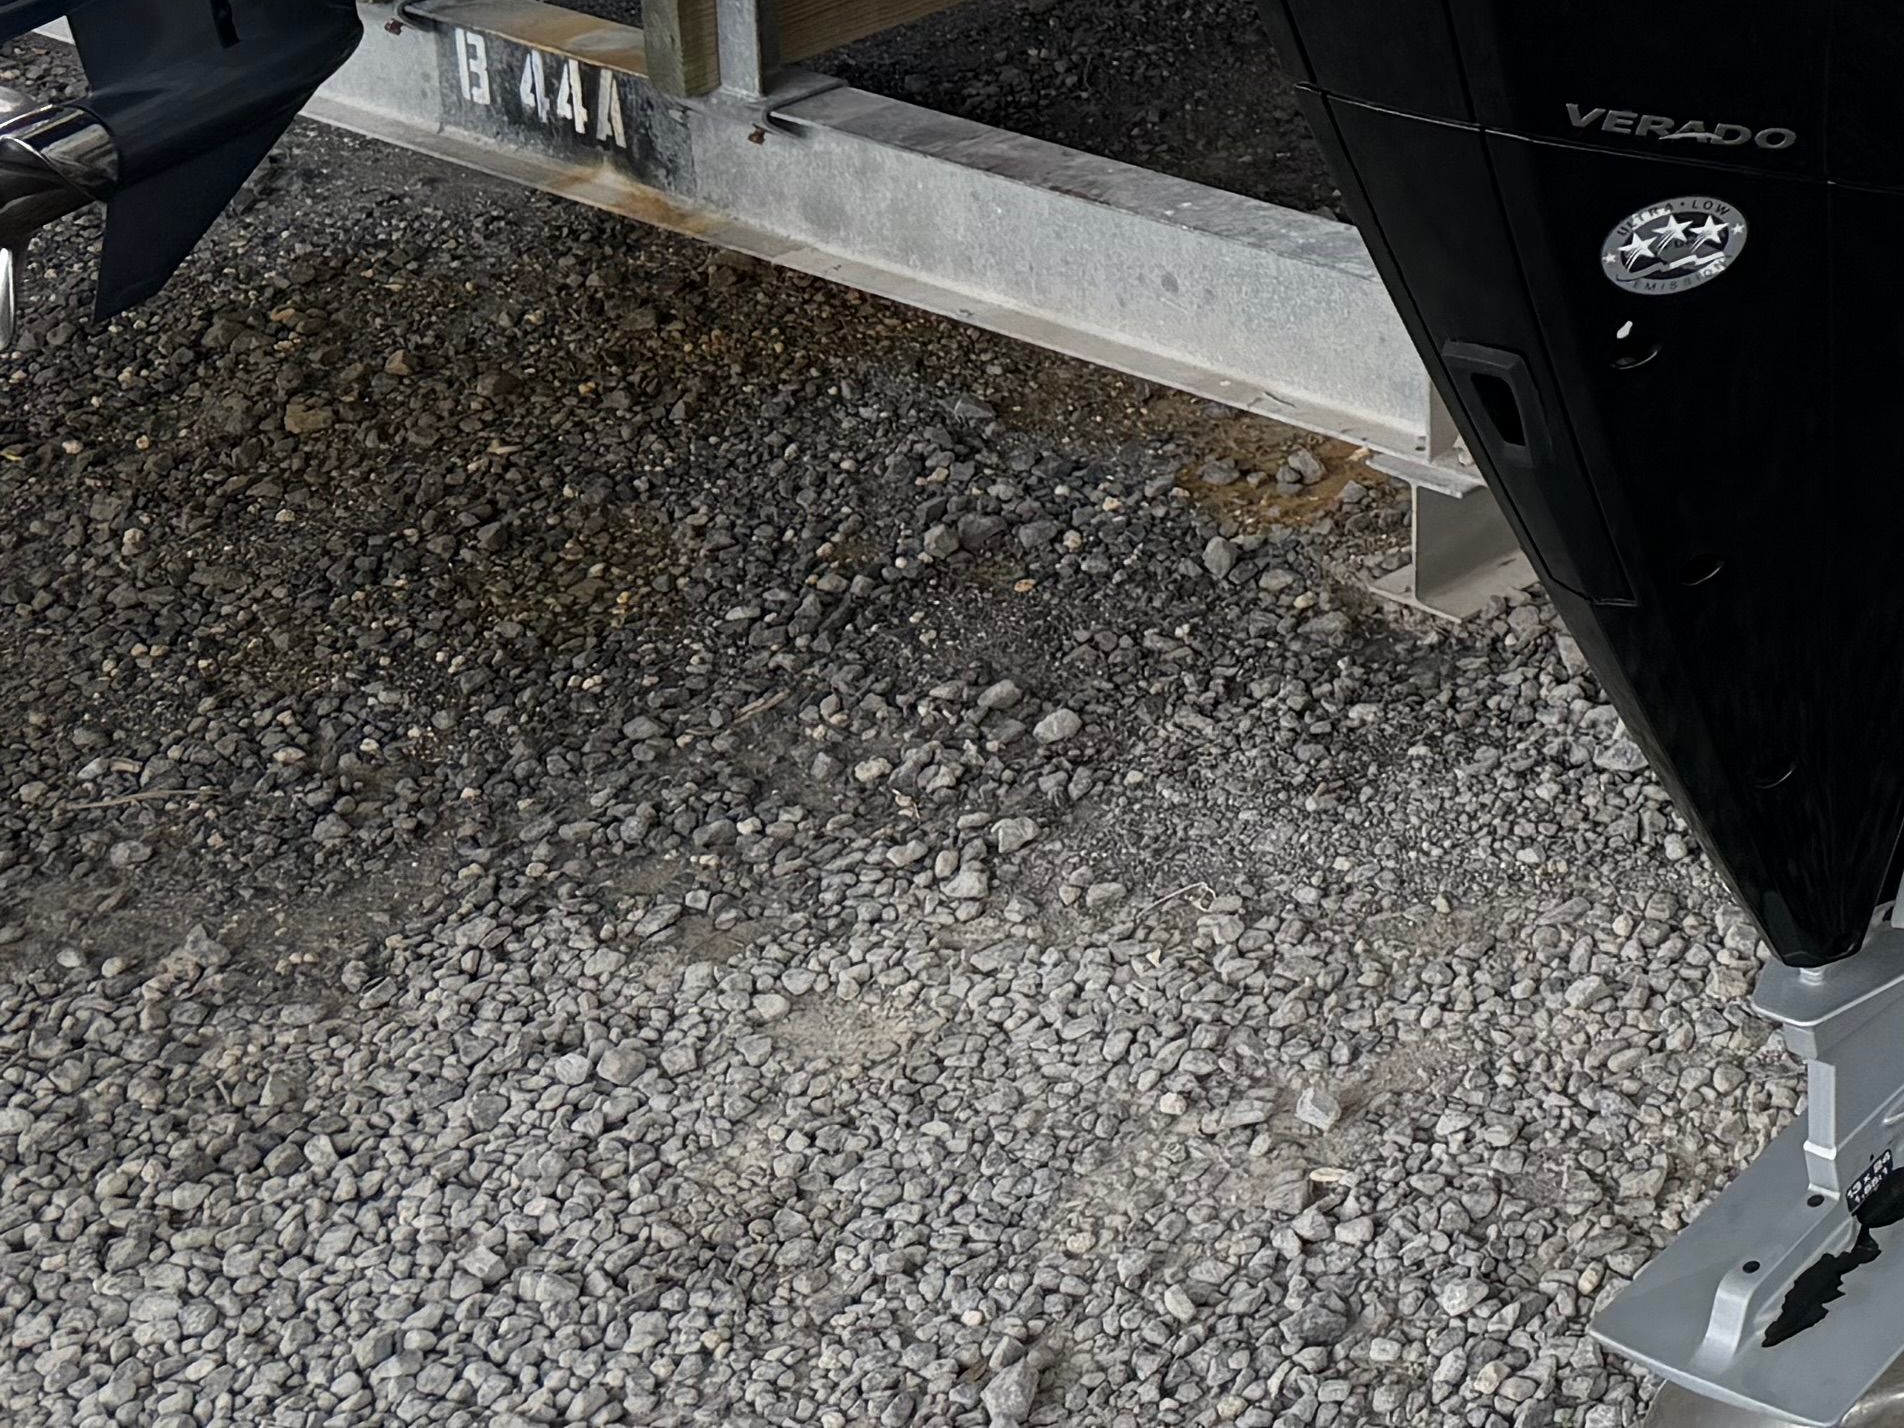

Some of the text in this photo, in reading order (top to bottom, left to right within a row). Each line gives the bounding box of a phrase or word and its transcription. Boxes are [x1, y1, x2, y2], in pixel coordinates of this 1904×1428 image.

[453, 26, 628, 150] B 44A
[1565, 102, 1798, 151] VERADO
[1616, 199, 1731, 238] ULTRA LOW
